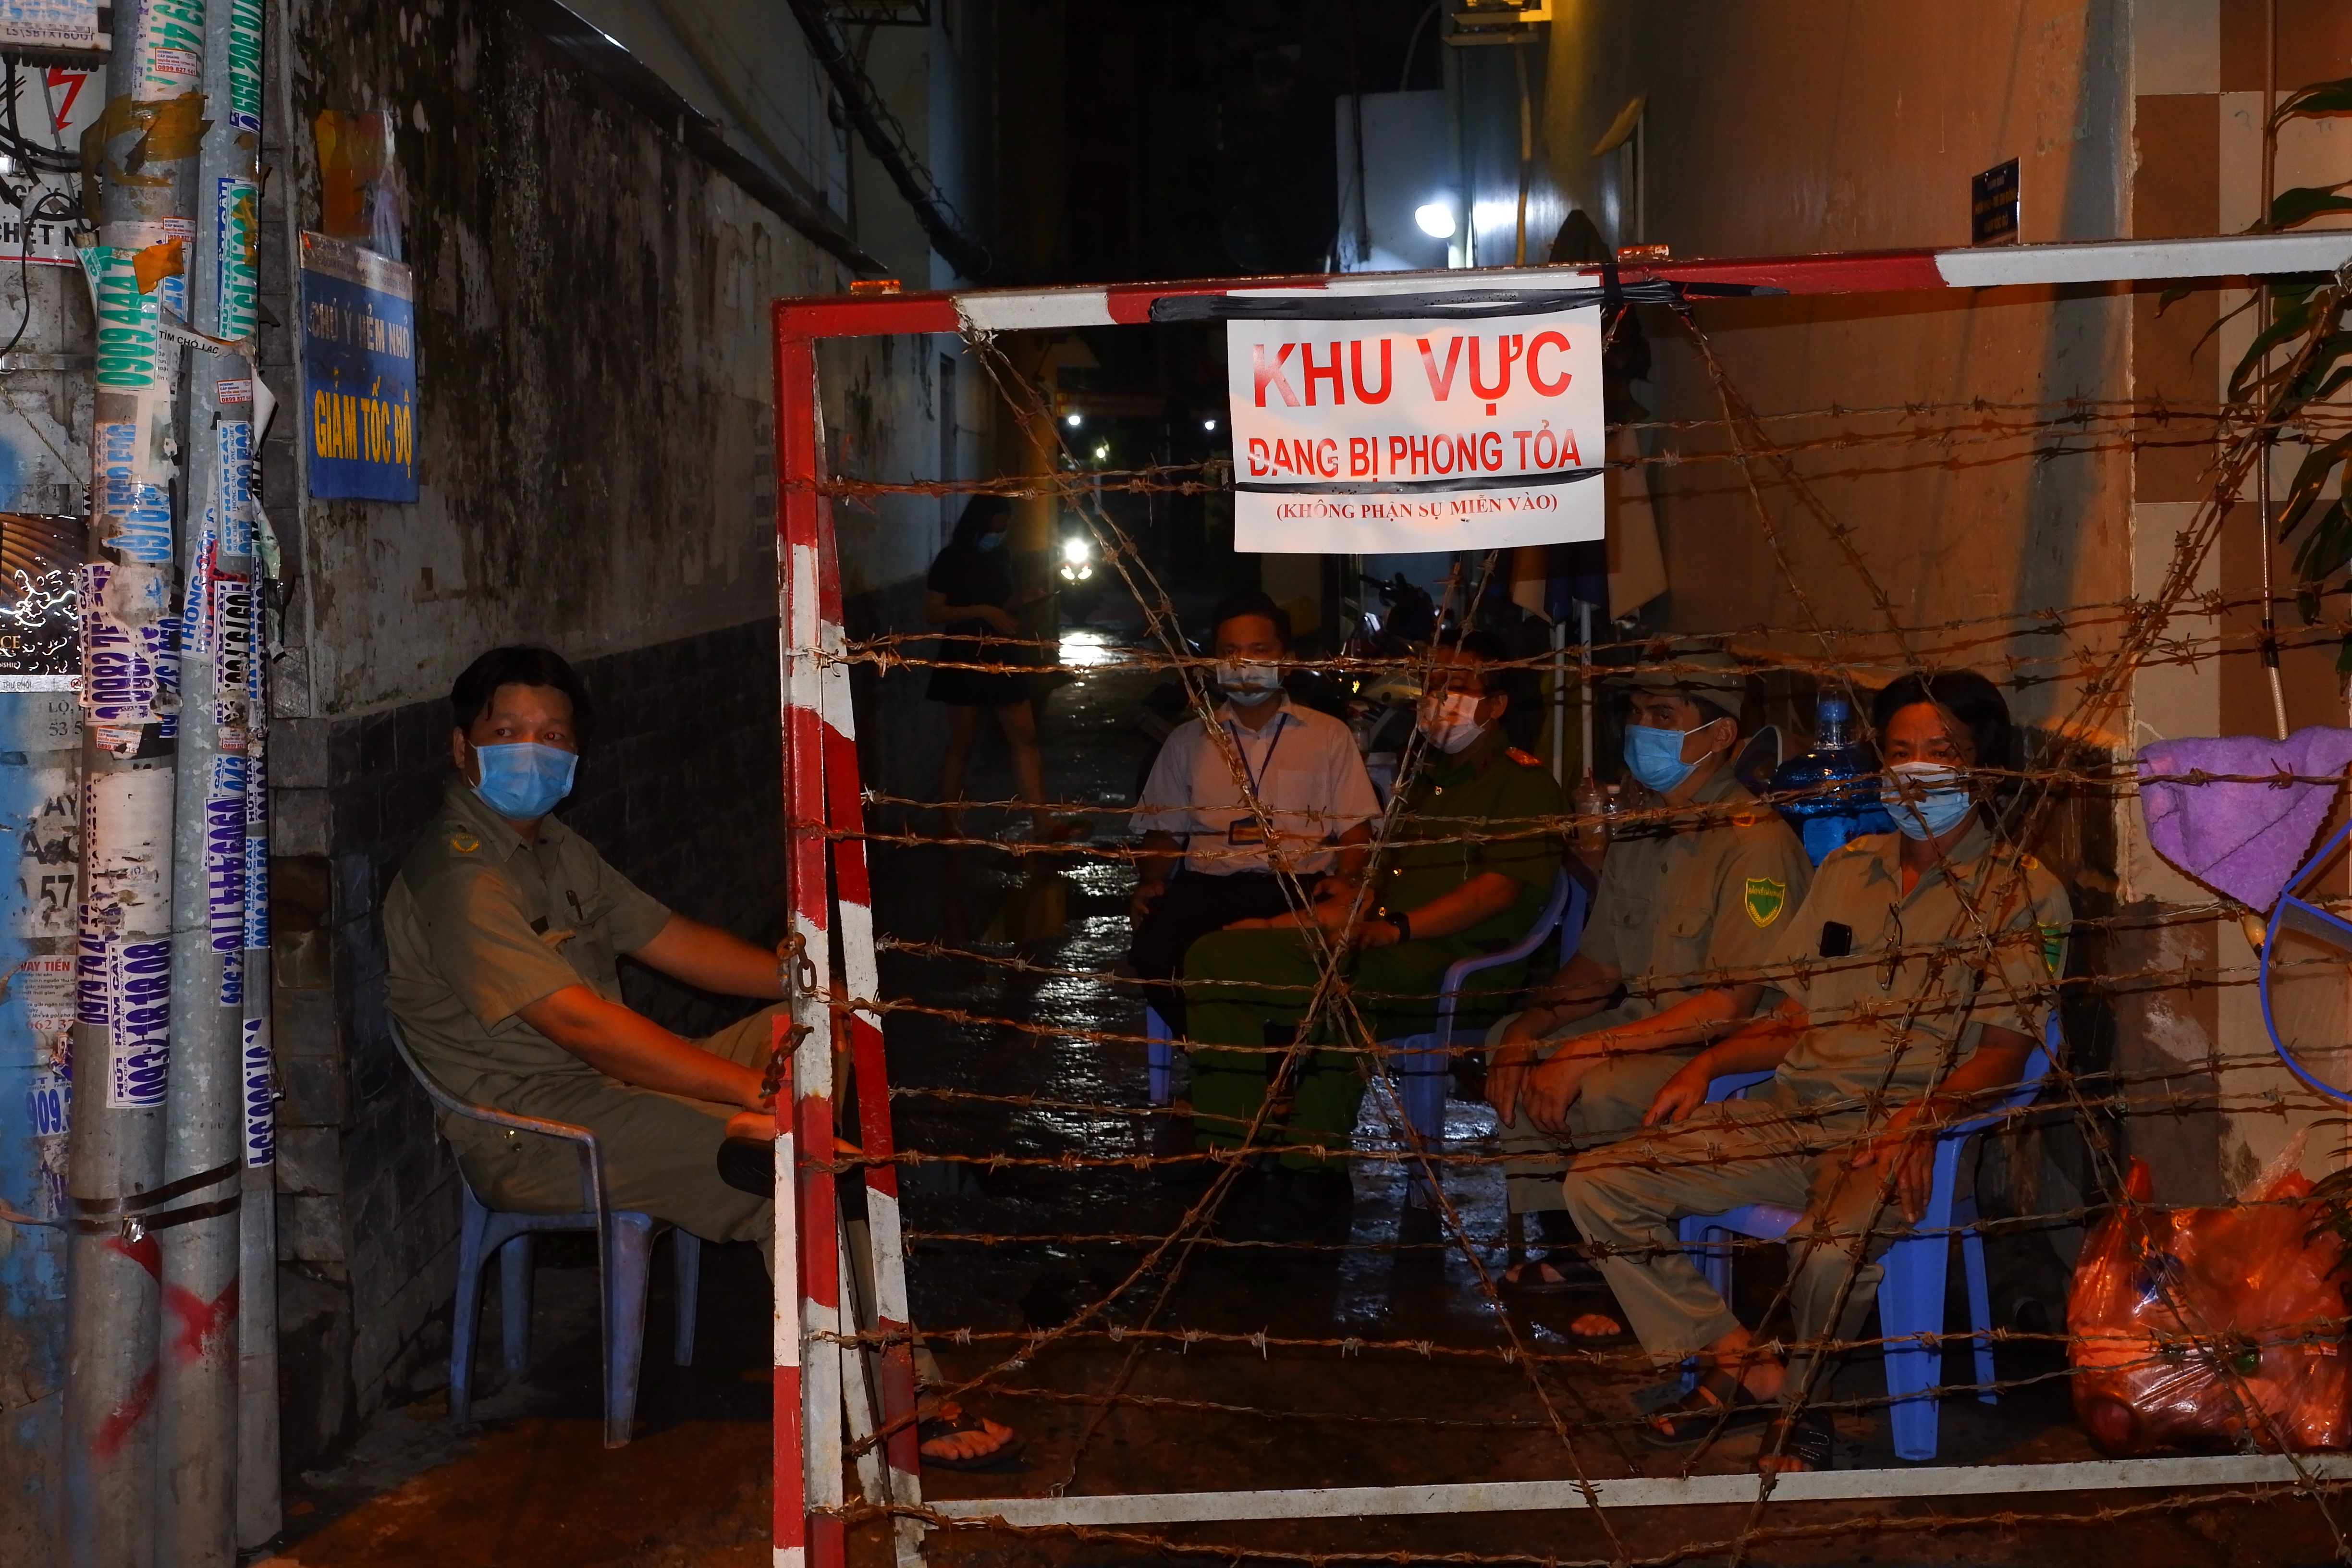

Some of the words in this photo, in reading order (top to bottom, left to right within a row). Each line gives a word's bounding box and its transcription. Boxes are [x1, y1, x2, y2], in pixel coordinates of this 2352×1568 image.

[159, 330, 174, 342] TÌM
[177, 337, 198, 348] CHÓ
[388, 315, 409, 359] NHỎ
[1253, 339, 1392, 407] KHU
[1417, 331, 1572, 416] VỰC
[315, 367, 357, 460] GIẢM
[361, 376, 391, 464] TỐC
[1248, 438, 1339, 477] ĐANG
[1350, 436, 1378, 482] BỊ
[1389, 431, 1502, 475] PHONG
[1513, 420, 1581, 470] TỎA
[1276, 499, 1355, 520] (KHÔNG
[1361, 502, 1413, 522] PHẬN
[1450, 490, 1502, 515] MIỄN
[1507, 493, 1558, 513] VÀO)
[49, 722, 68, 736] 53
[45, 958, 70, 971] TIỀN
